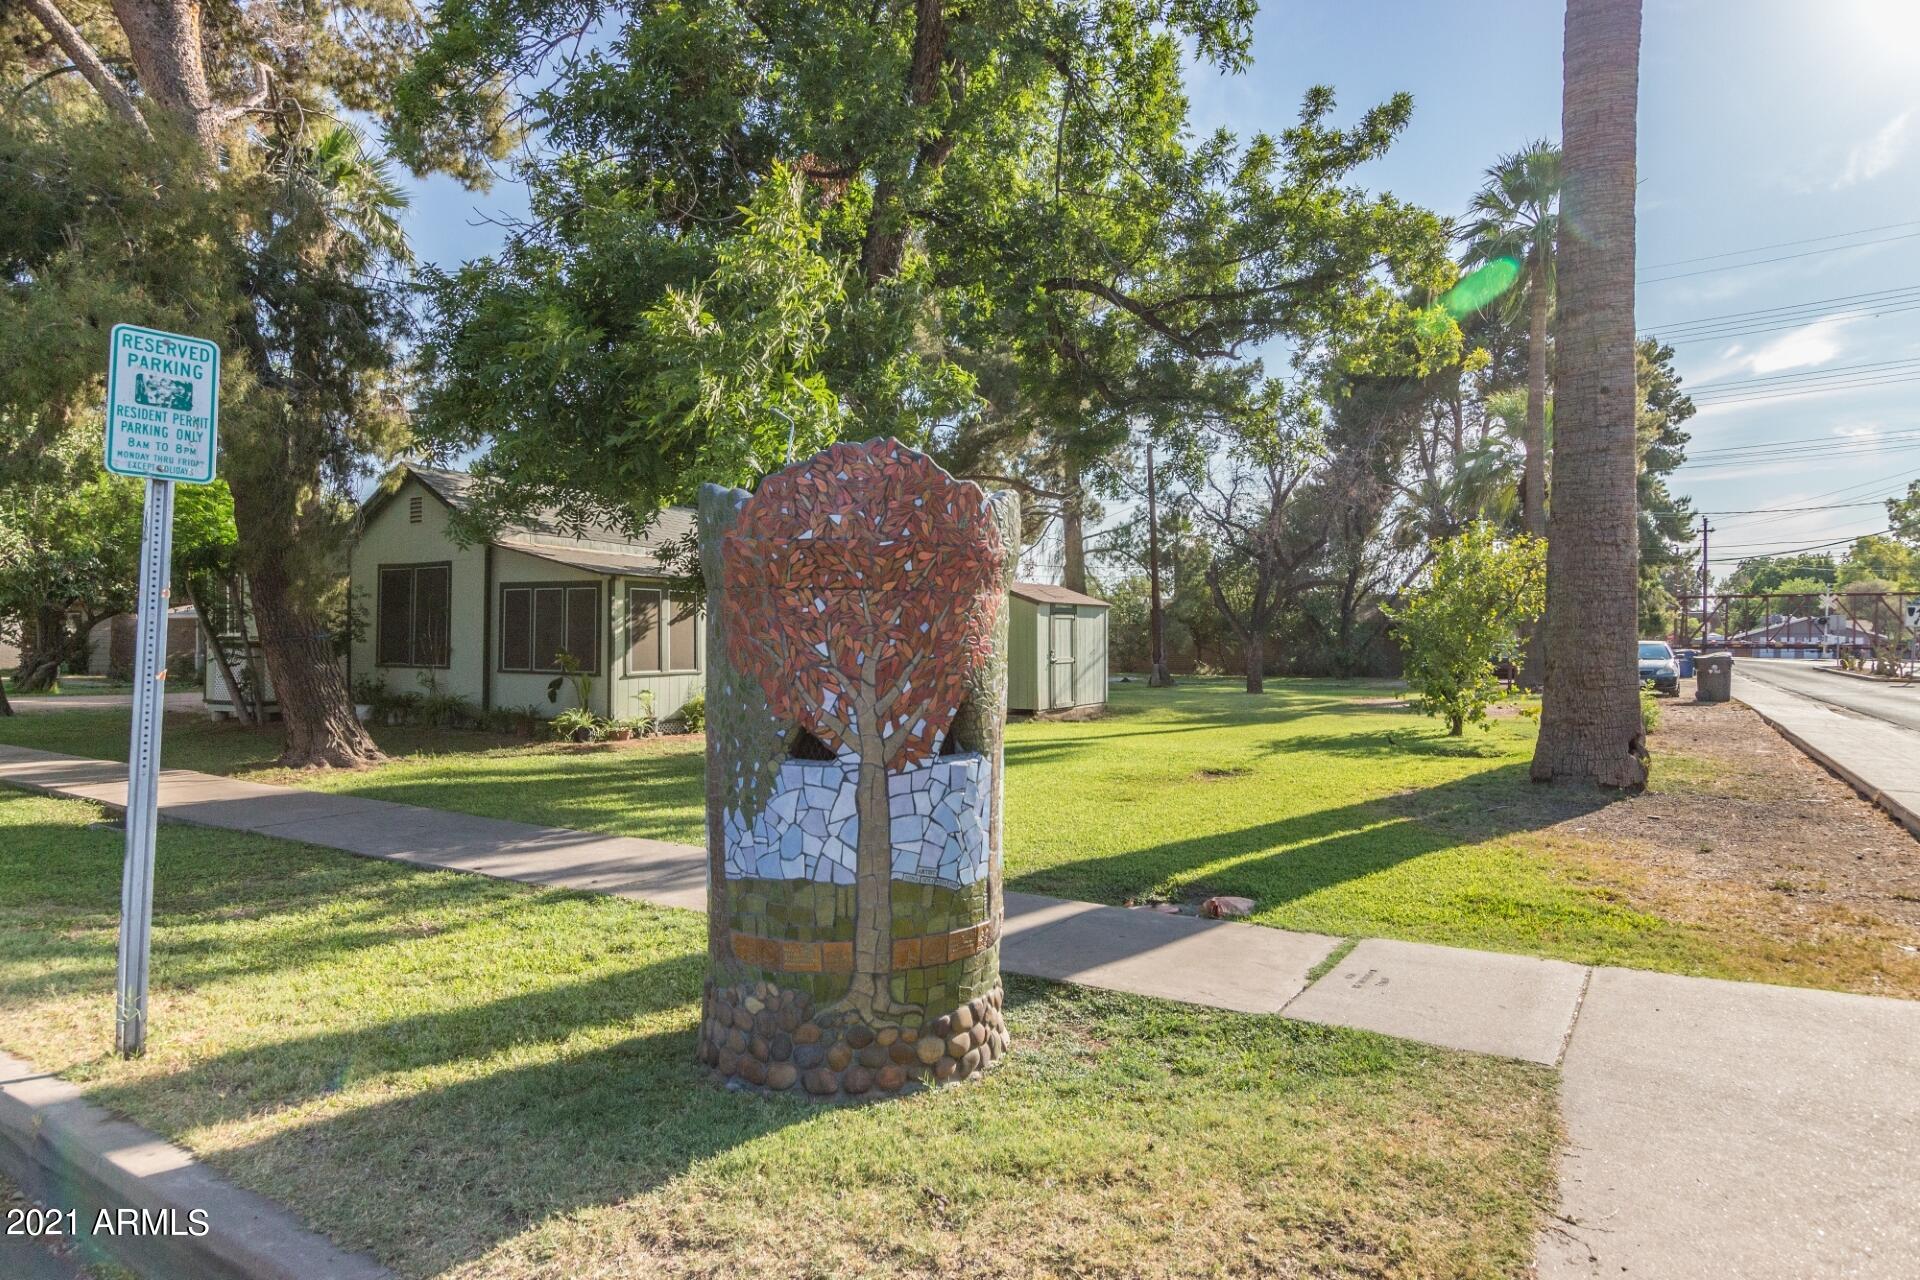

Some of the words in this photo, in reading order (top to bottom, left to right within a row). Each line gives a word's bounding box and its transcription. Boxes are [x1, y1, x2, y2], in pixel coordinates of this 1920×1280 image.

[122, 333, 210, 363] RESERVED
[127, 352, 203, 380] PARKING
[116, 404, 168, 423] RESIDENT
[172, 412, 209, 429] PERMIT
[121, 420, 169, 438] PARKING
[176, 428, 204, 443] ONLY
[117, 450, 150, 461] MONDAY
[154, 454, 174, 464] THRU
[128, 437, 149, 449] 8AM
[156, 442, 169, 452] TO
[176, 443, 197, 456] 8PM
[127, 461, 155, 471] EXCEPT
[157, 465, 194, 476] OLIDAYS
